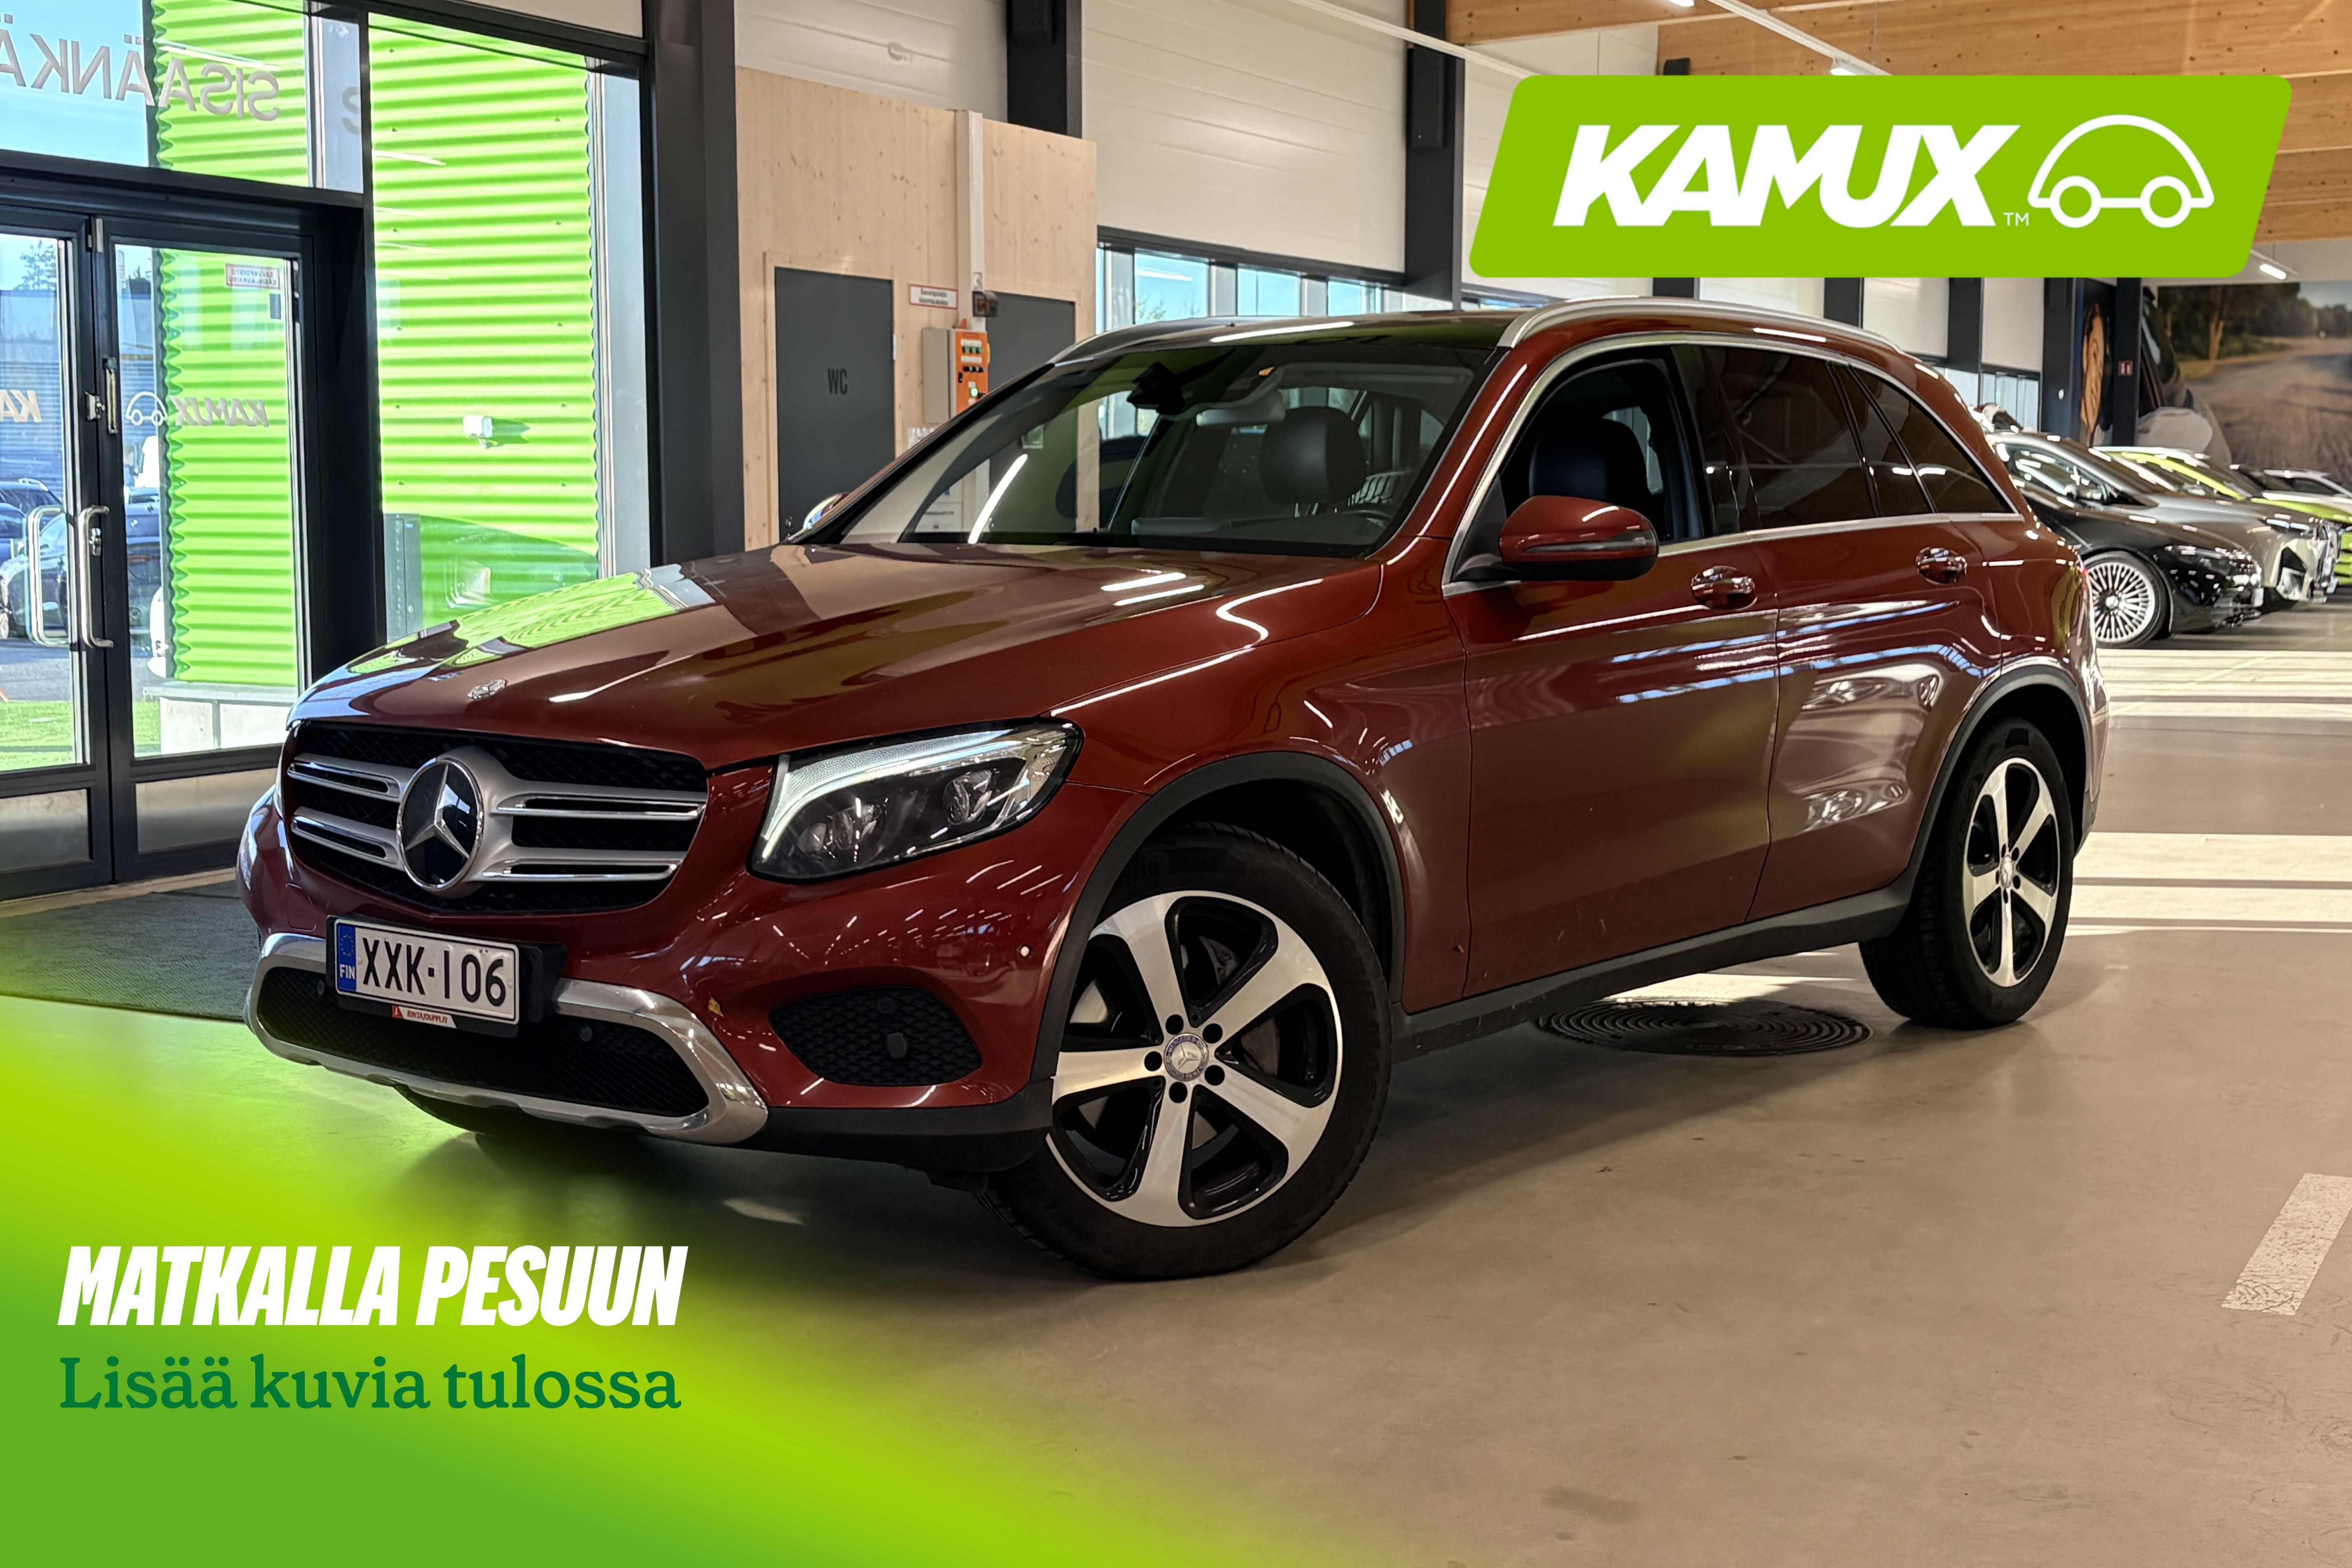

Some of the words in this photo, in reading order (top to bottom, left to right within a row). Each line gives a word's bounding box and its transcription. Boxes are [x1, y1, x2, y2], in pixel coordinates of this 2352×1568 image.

[827, 368, 848, 395] WC
[339, 964, 355, 980] FIN
[362, 937, 506, 1007] XXK-106
